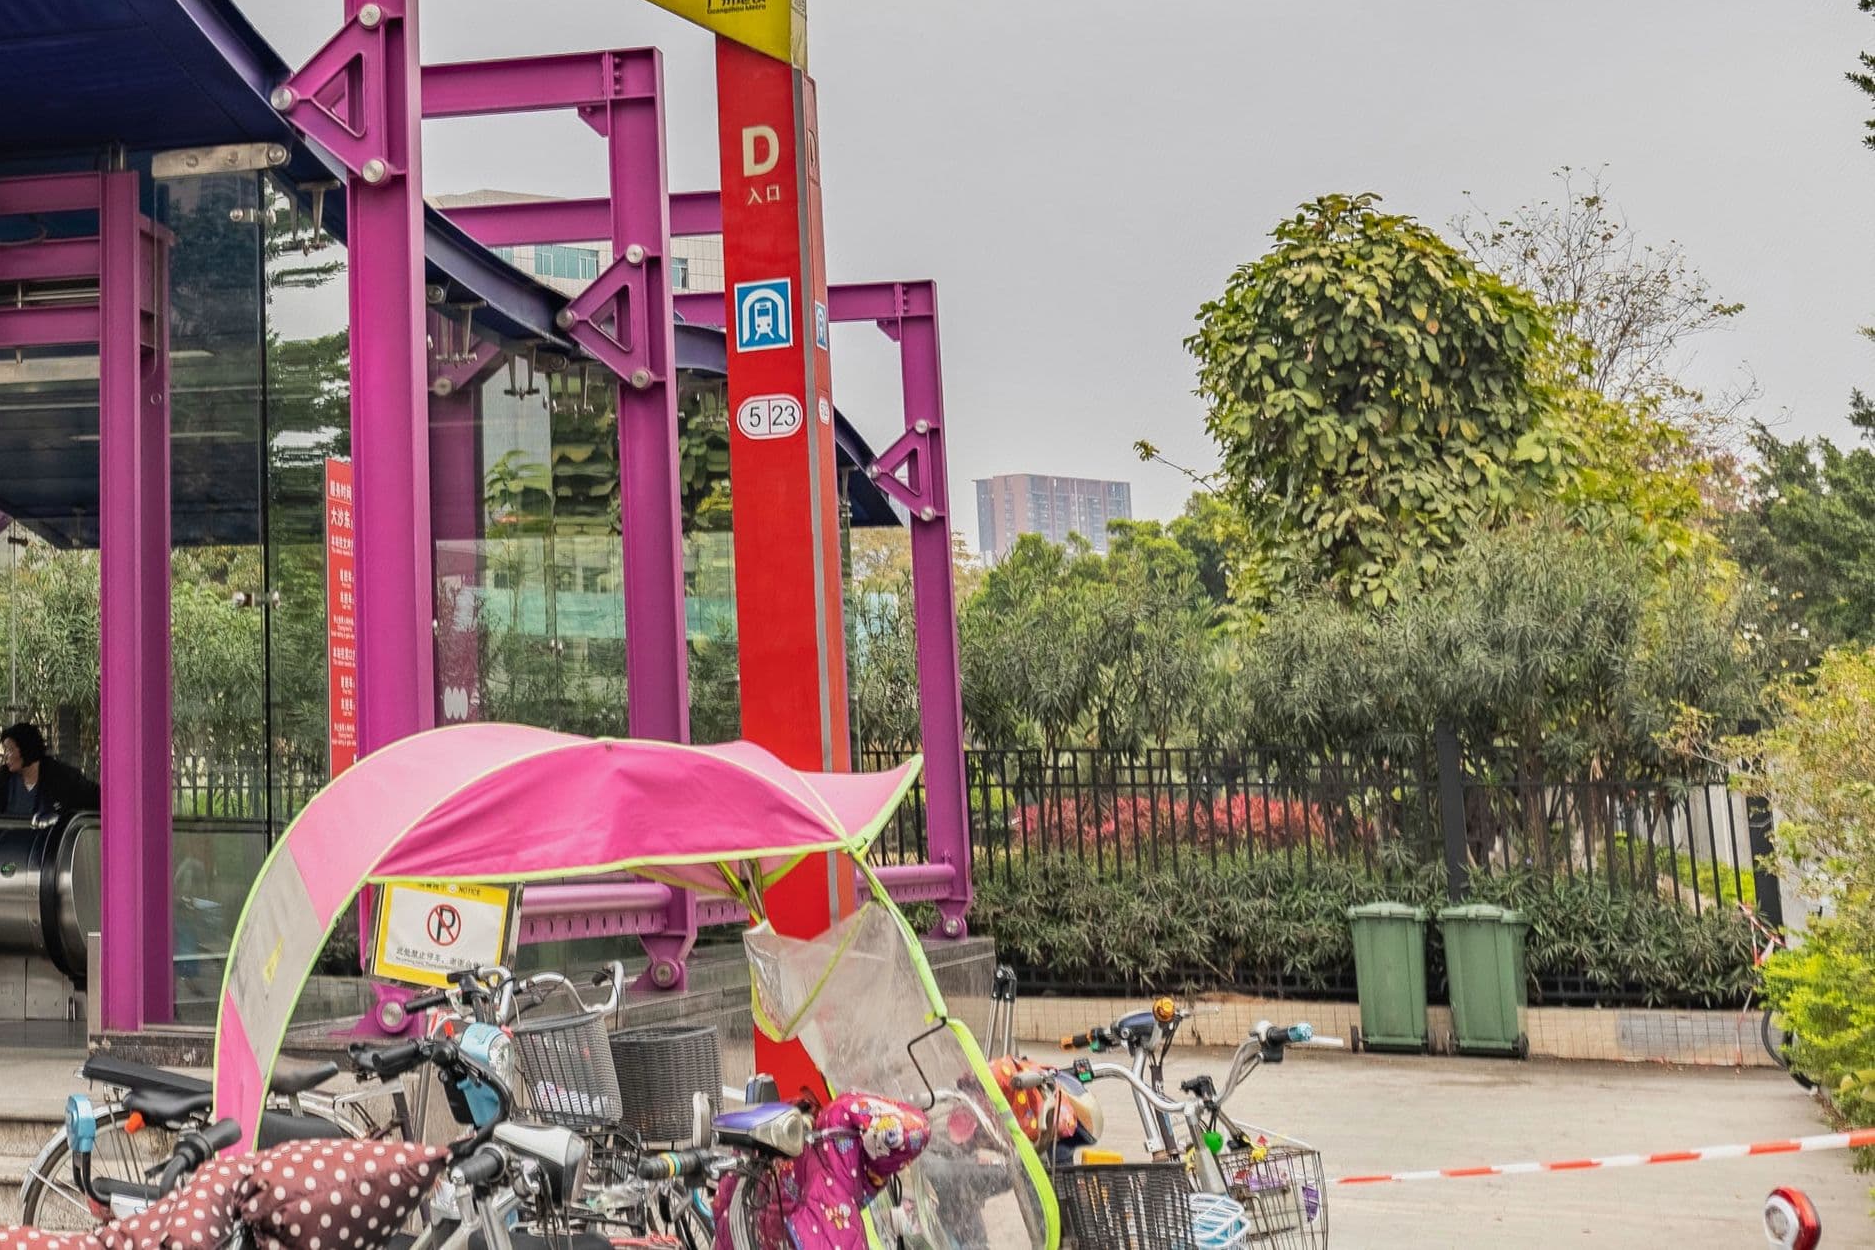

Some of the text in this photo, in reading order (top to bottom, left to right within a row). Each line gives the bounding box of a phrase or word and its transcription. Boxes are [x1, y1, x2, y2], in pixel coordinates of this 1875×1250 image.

[742, 125, 779, 177] D
[747, 184, 780, 205] 入口
[749, 406, 761, 427] 5
[772, 405, 796, 426] 23
[331, 506, 353, 530] 大沙东
